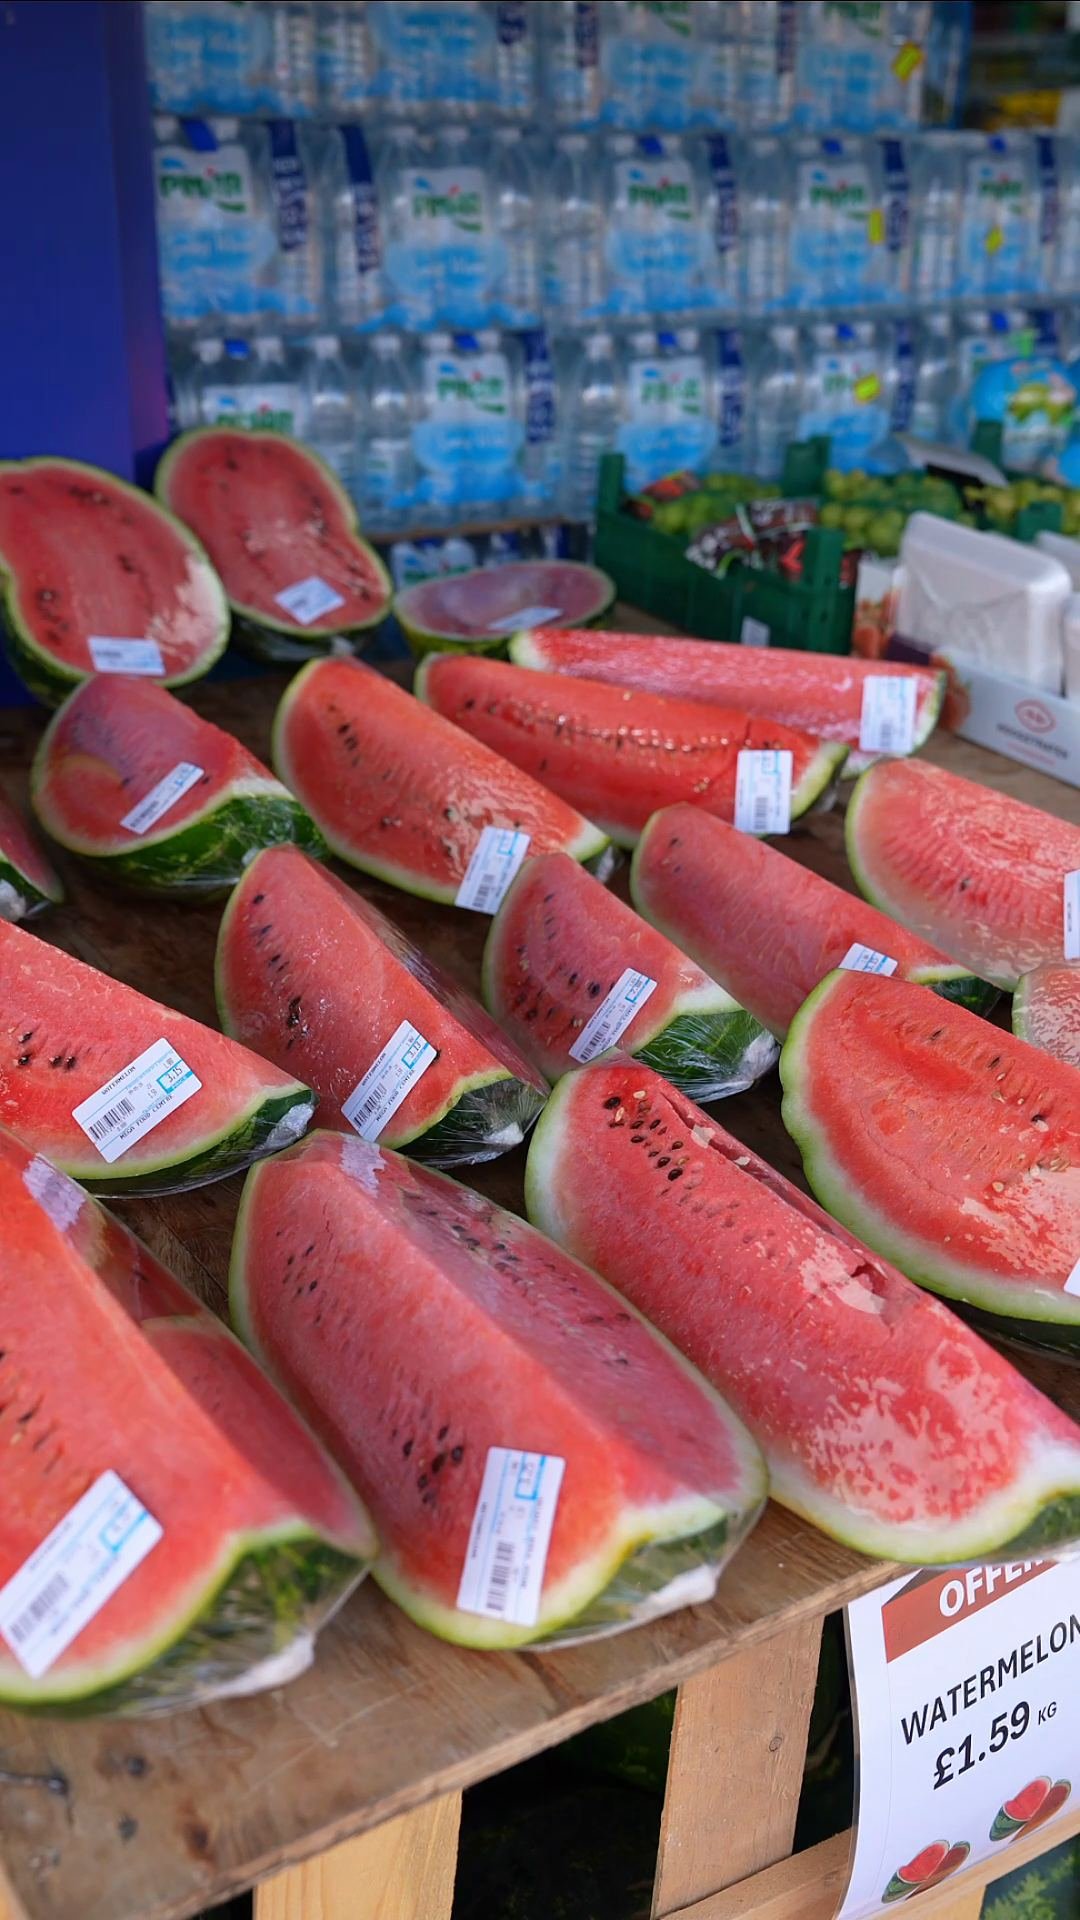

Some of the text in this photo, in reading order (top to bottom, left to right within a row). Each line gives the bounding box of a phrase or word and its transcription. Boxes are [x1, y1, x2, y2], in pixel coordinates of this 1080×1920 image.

[101, 1066, 136, 1095] WATERMELON
[167, 1067, 183, 1083] 3.15
[120, 1126, 135, 1139] MEGA
[136, 1112, 151, 1127] FOOD
[933, 1700, 1057, 1790] £1.59 KG
